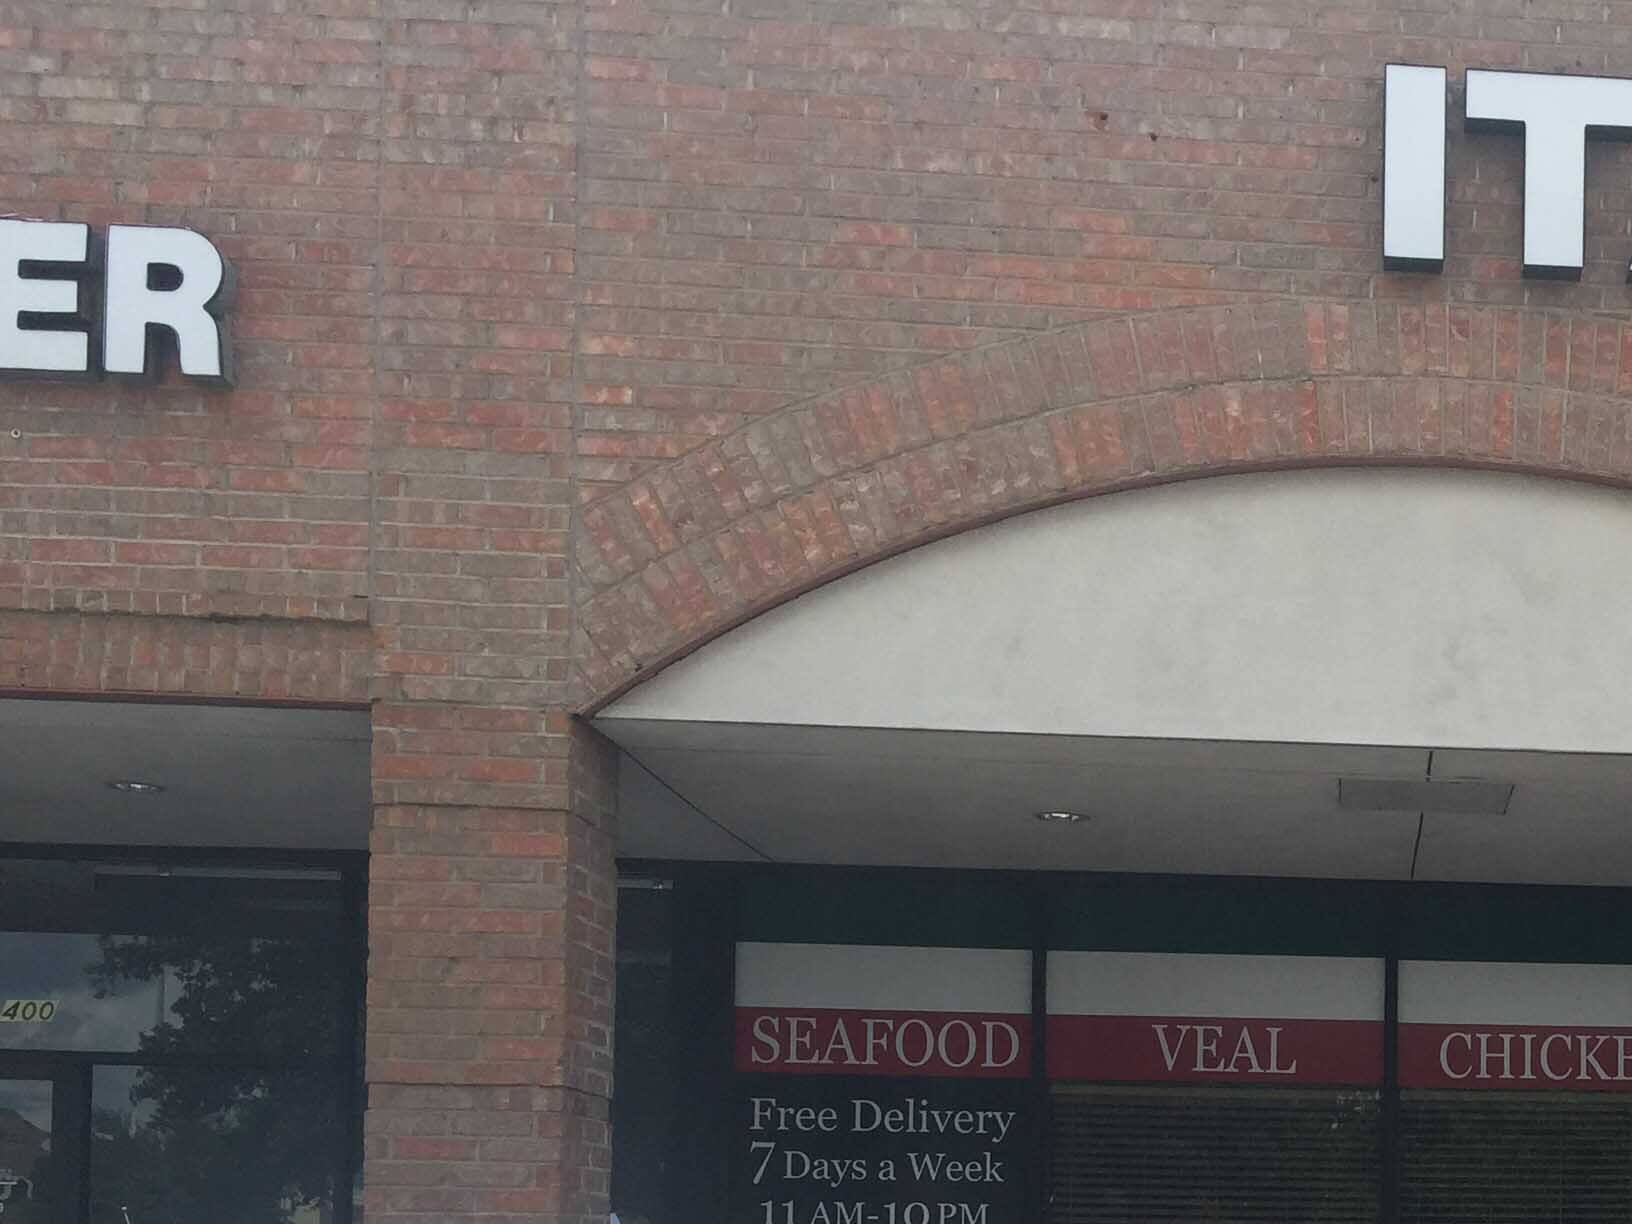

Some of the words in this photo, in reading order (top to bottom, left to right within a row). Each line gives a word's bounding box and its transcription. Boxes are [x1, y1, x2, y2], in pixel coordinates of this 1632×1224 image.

[0, 217, 226, 378] ER
[1, 1000, 55, 1021] 400
[750, 1016, 1020, 1069] SEAFOOD
[1152, 1023, 1297, 1074] VEAL
[750, 1098, 838, 1132] Free
[850, 1098, 1016, 1143] Delivery
[750, 1141, 776, 1184] 7
[783, 1150, 867, 1188] Days
[878, 1159, 896, 1181] a
[907, 1152, 1005, 1182] Week
